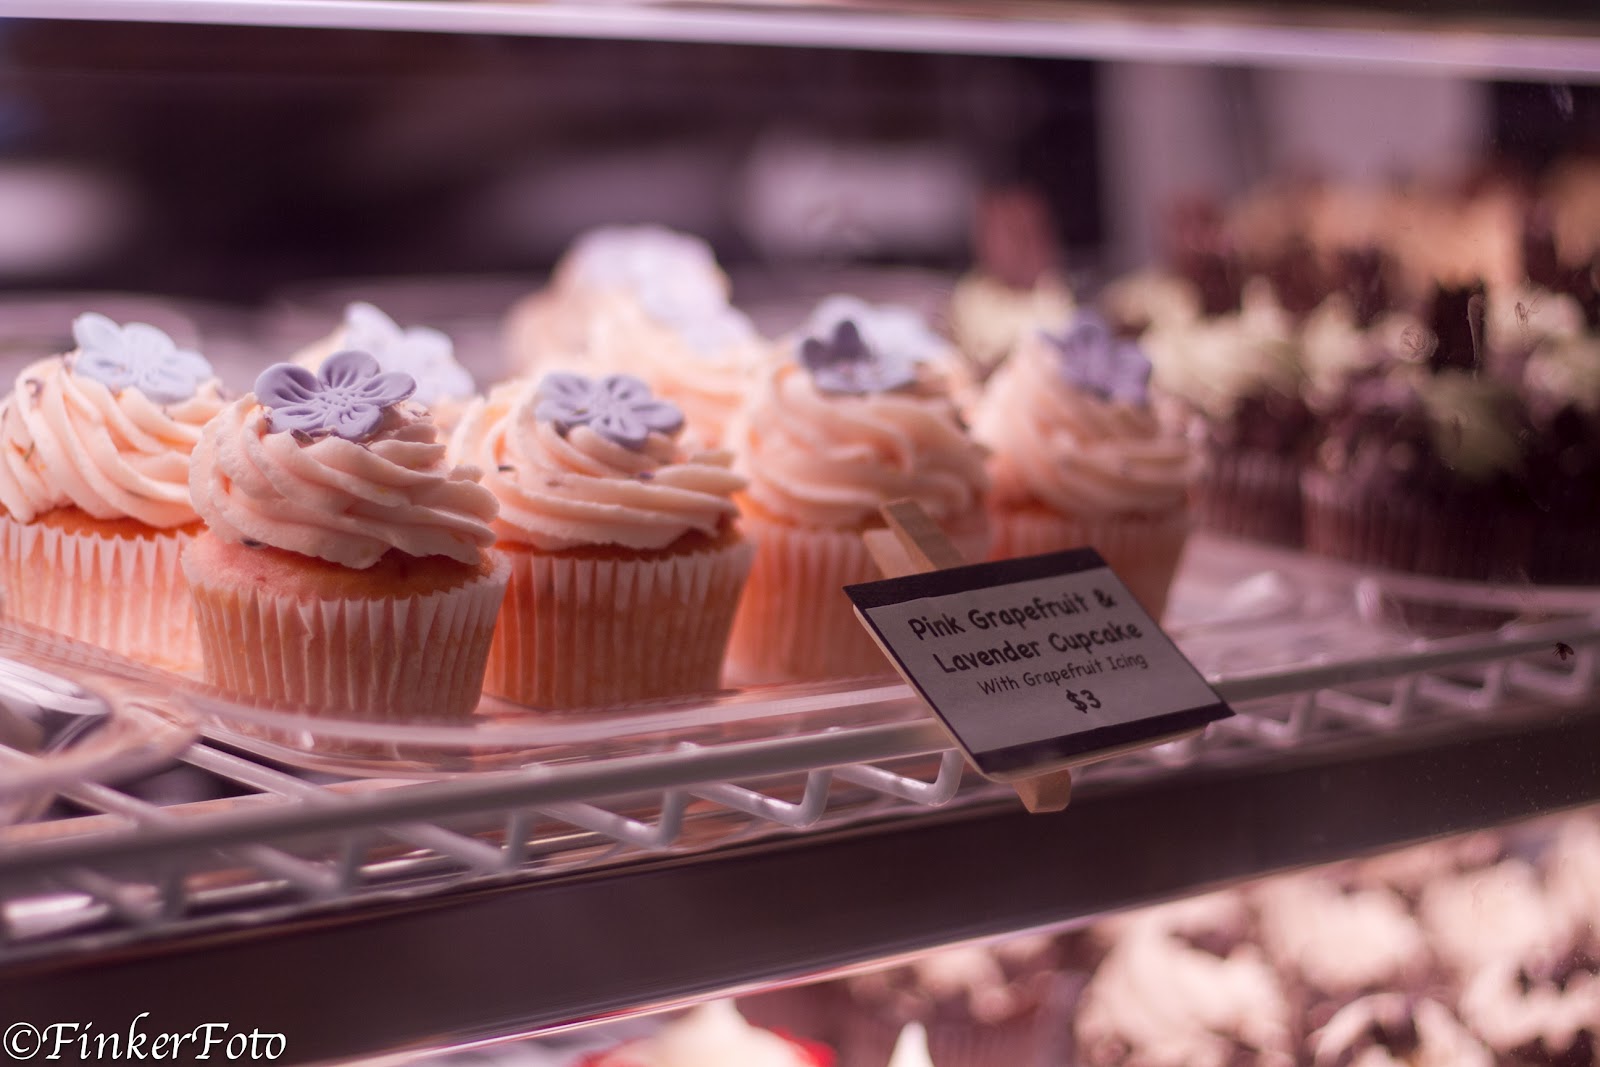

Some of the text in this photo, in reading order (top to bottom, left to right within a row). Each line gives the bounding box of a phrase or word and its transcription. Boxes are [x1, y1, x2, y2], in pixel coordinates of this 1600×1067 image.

[908, 588, 1118, 641] Pink Grapefruit &
[933, 620, 1143, 674] Lavender Cupcake
[977, 652, 1149, 695] With Grapefruit Icing
[1065, 689, 1101, 714] $3
